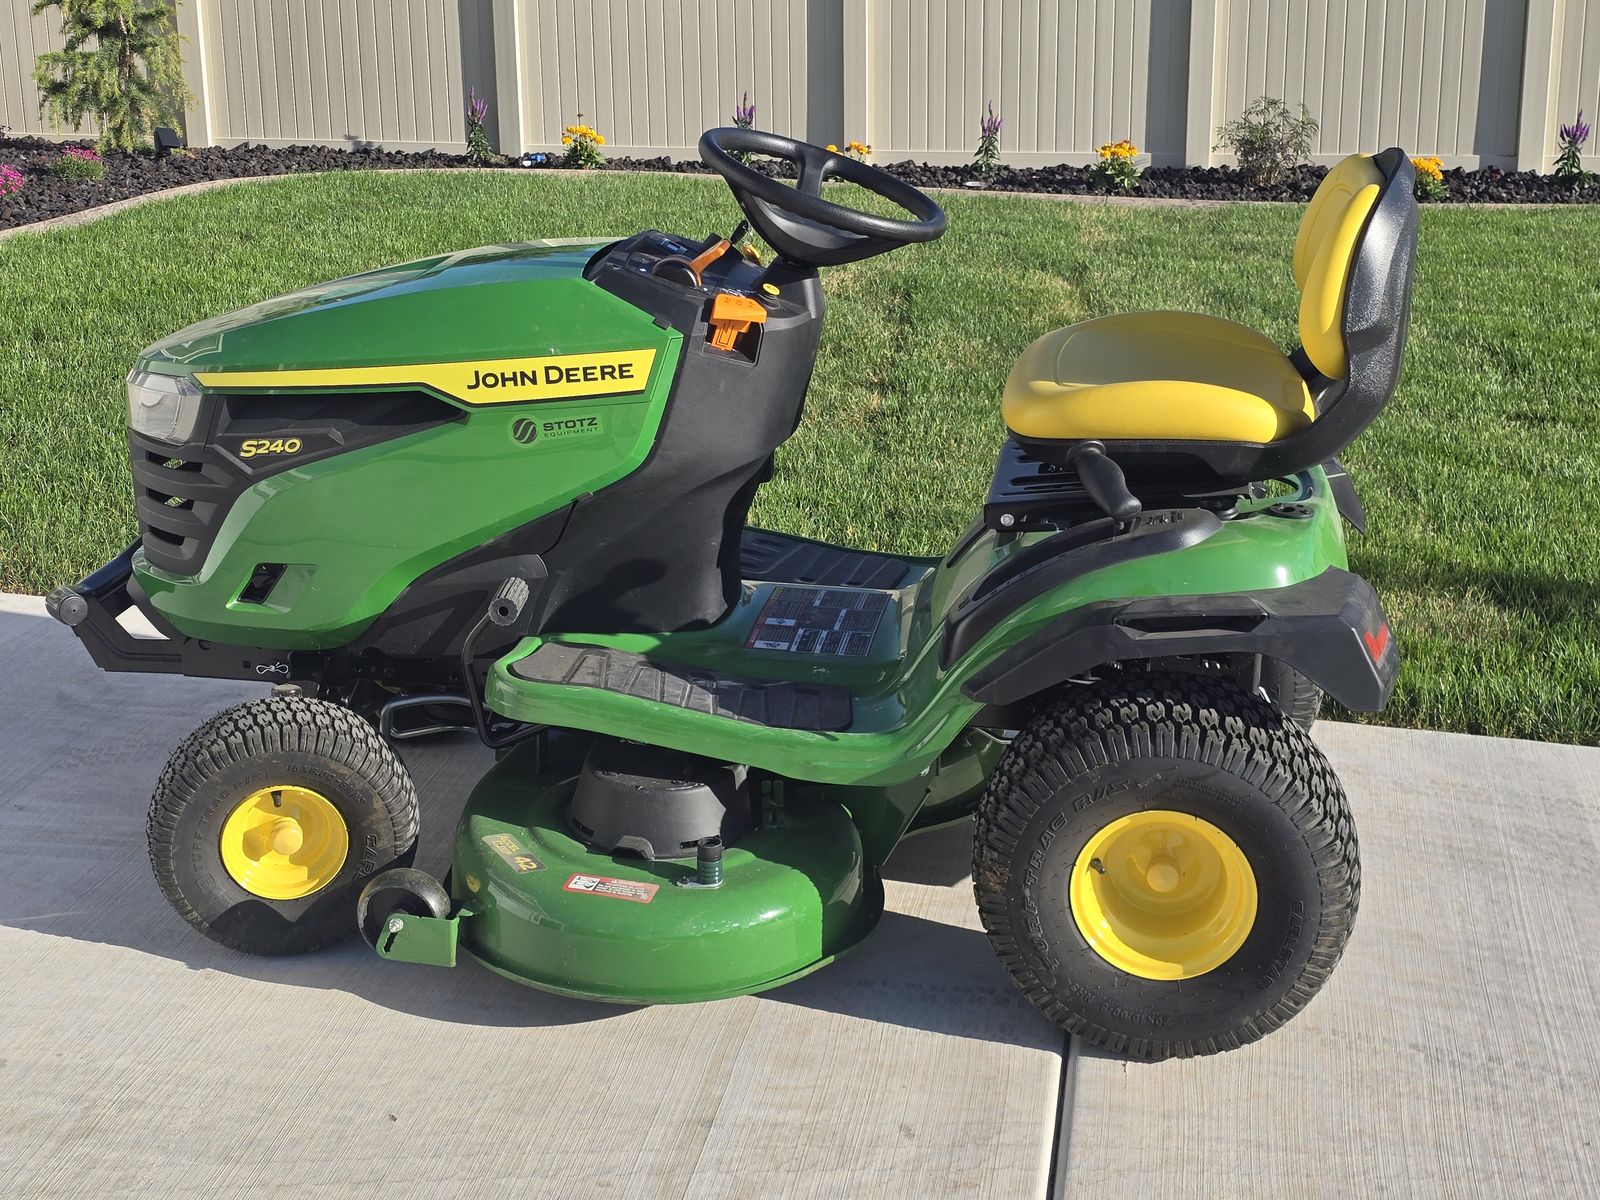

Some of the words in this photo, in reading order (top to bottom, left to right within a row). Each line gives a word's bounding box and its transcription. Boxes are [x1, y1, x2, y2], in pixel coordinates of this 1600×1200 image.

[467, 370, 538, 389] JOHN
[544, 363, 634, 384] DEERE
[543, 417, 598, 431] STOTZ
[544, 427, 599, 437] EQUIPMENT
[240, 438, 302, 458] S240
[1024, 811, 1068, 886] TRAC
[515, 856, 537, 871] 42
[1024, 896, 1060, 972] TURF
